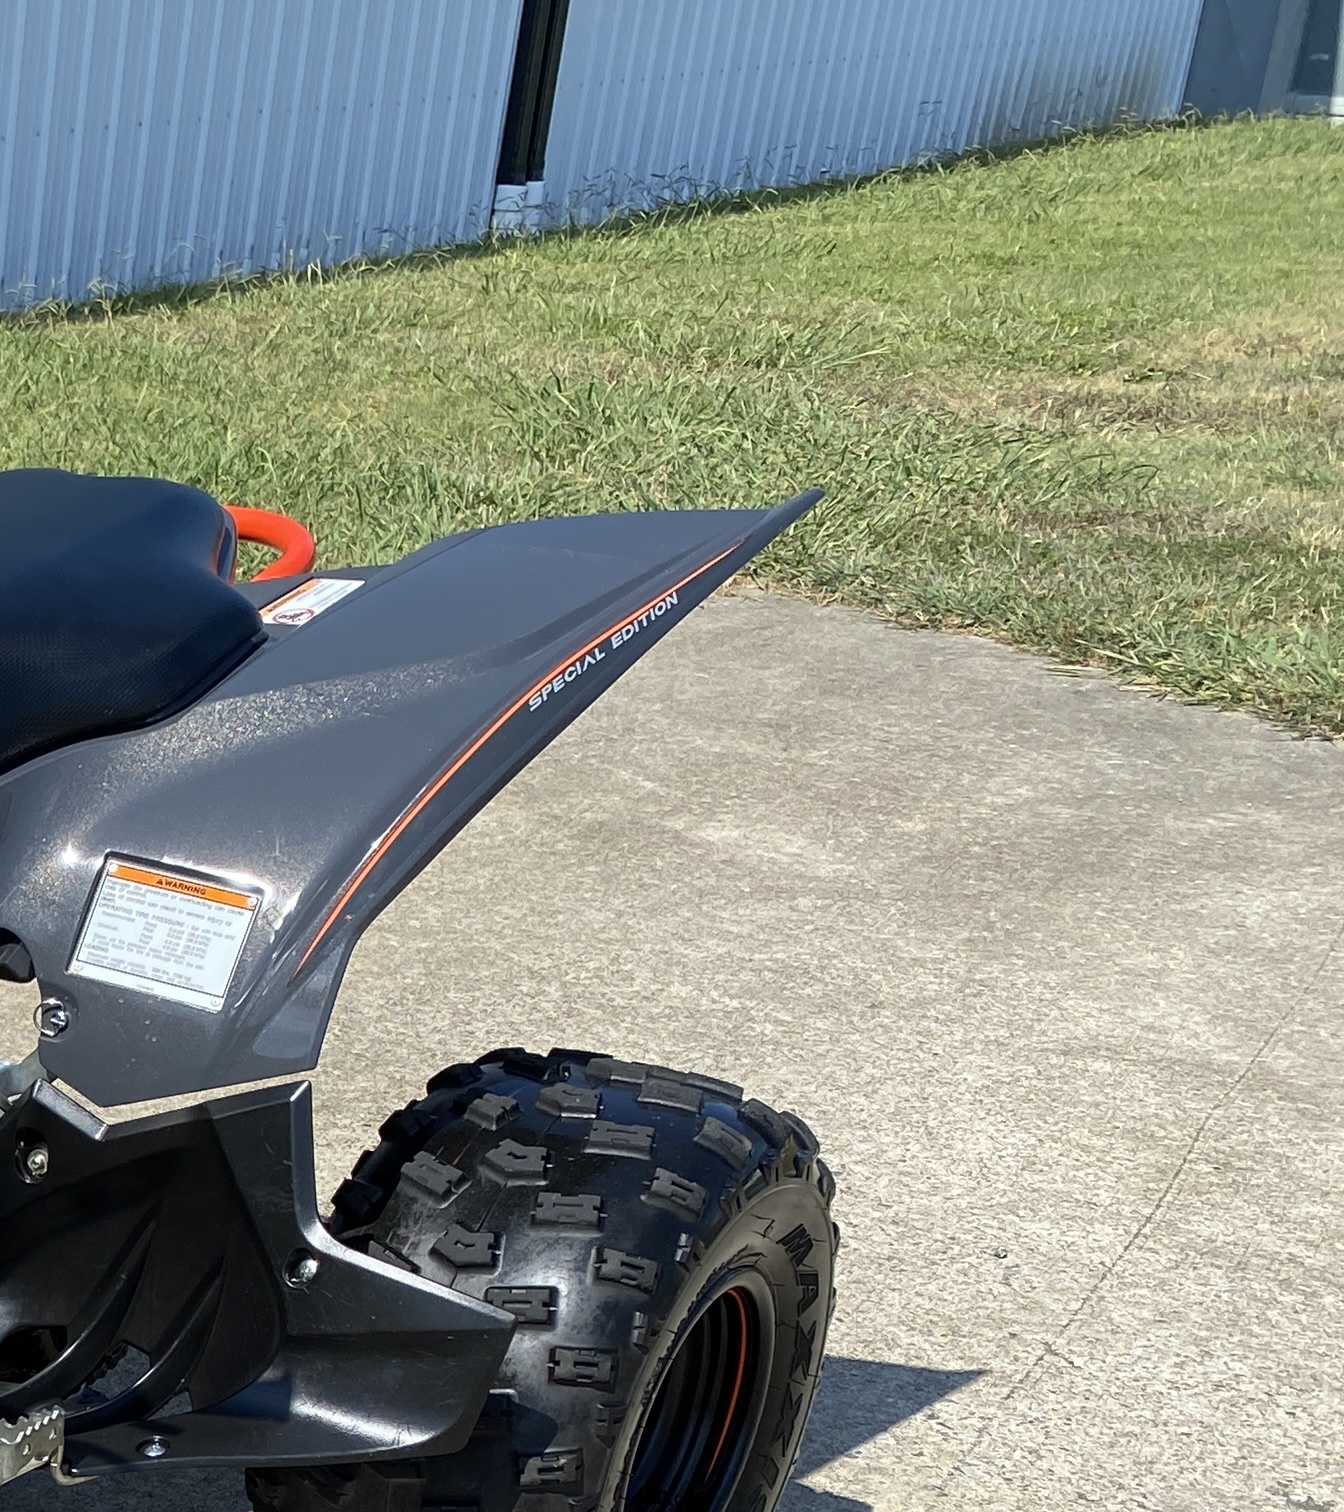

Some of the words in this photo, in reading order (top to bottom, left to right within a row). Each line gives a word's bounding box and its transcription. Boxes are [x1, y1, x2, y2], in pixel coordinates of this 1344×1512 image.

[529, 647, 606, 711] SPECIAL
[610, 591, 679, 650] EDITION
[163, 879, 207, 896] WARNING
